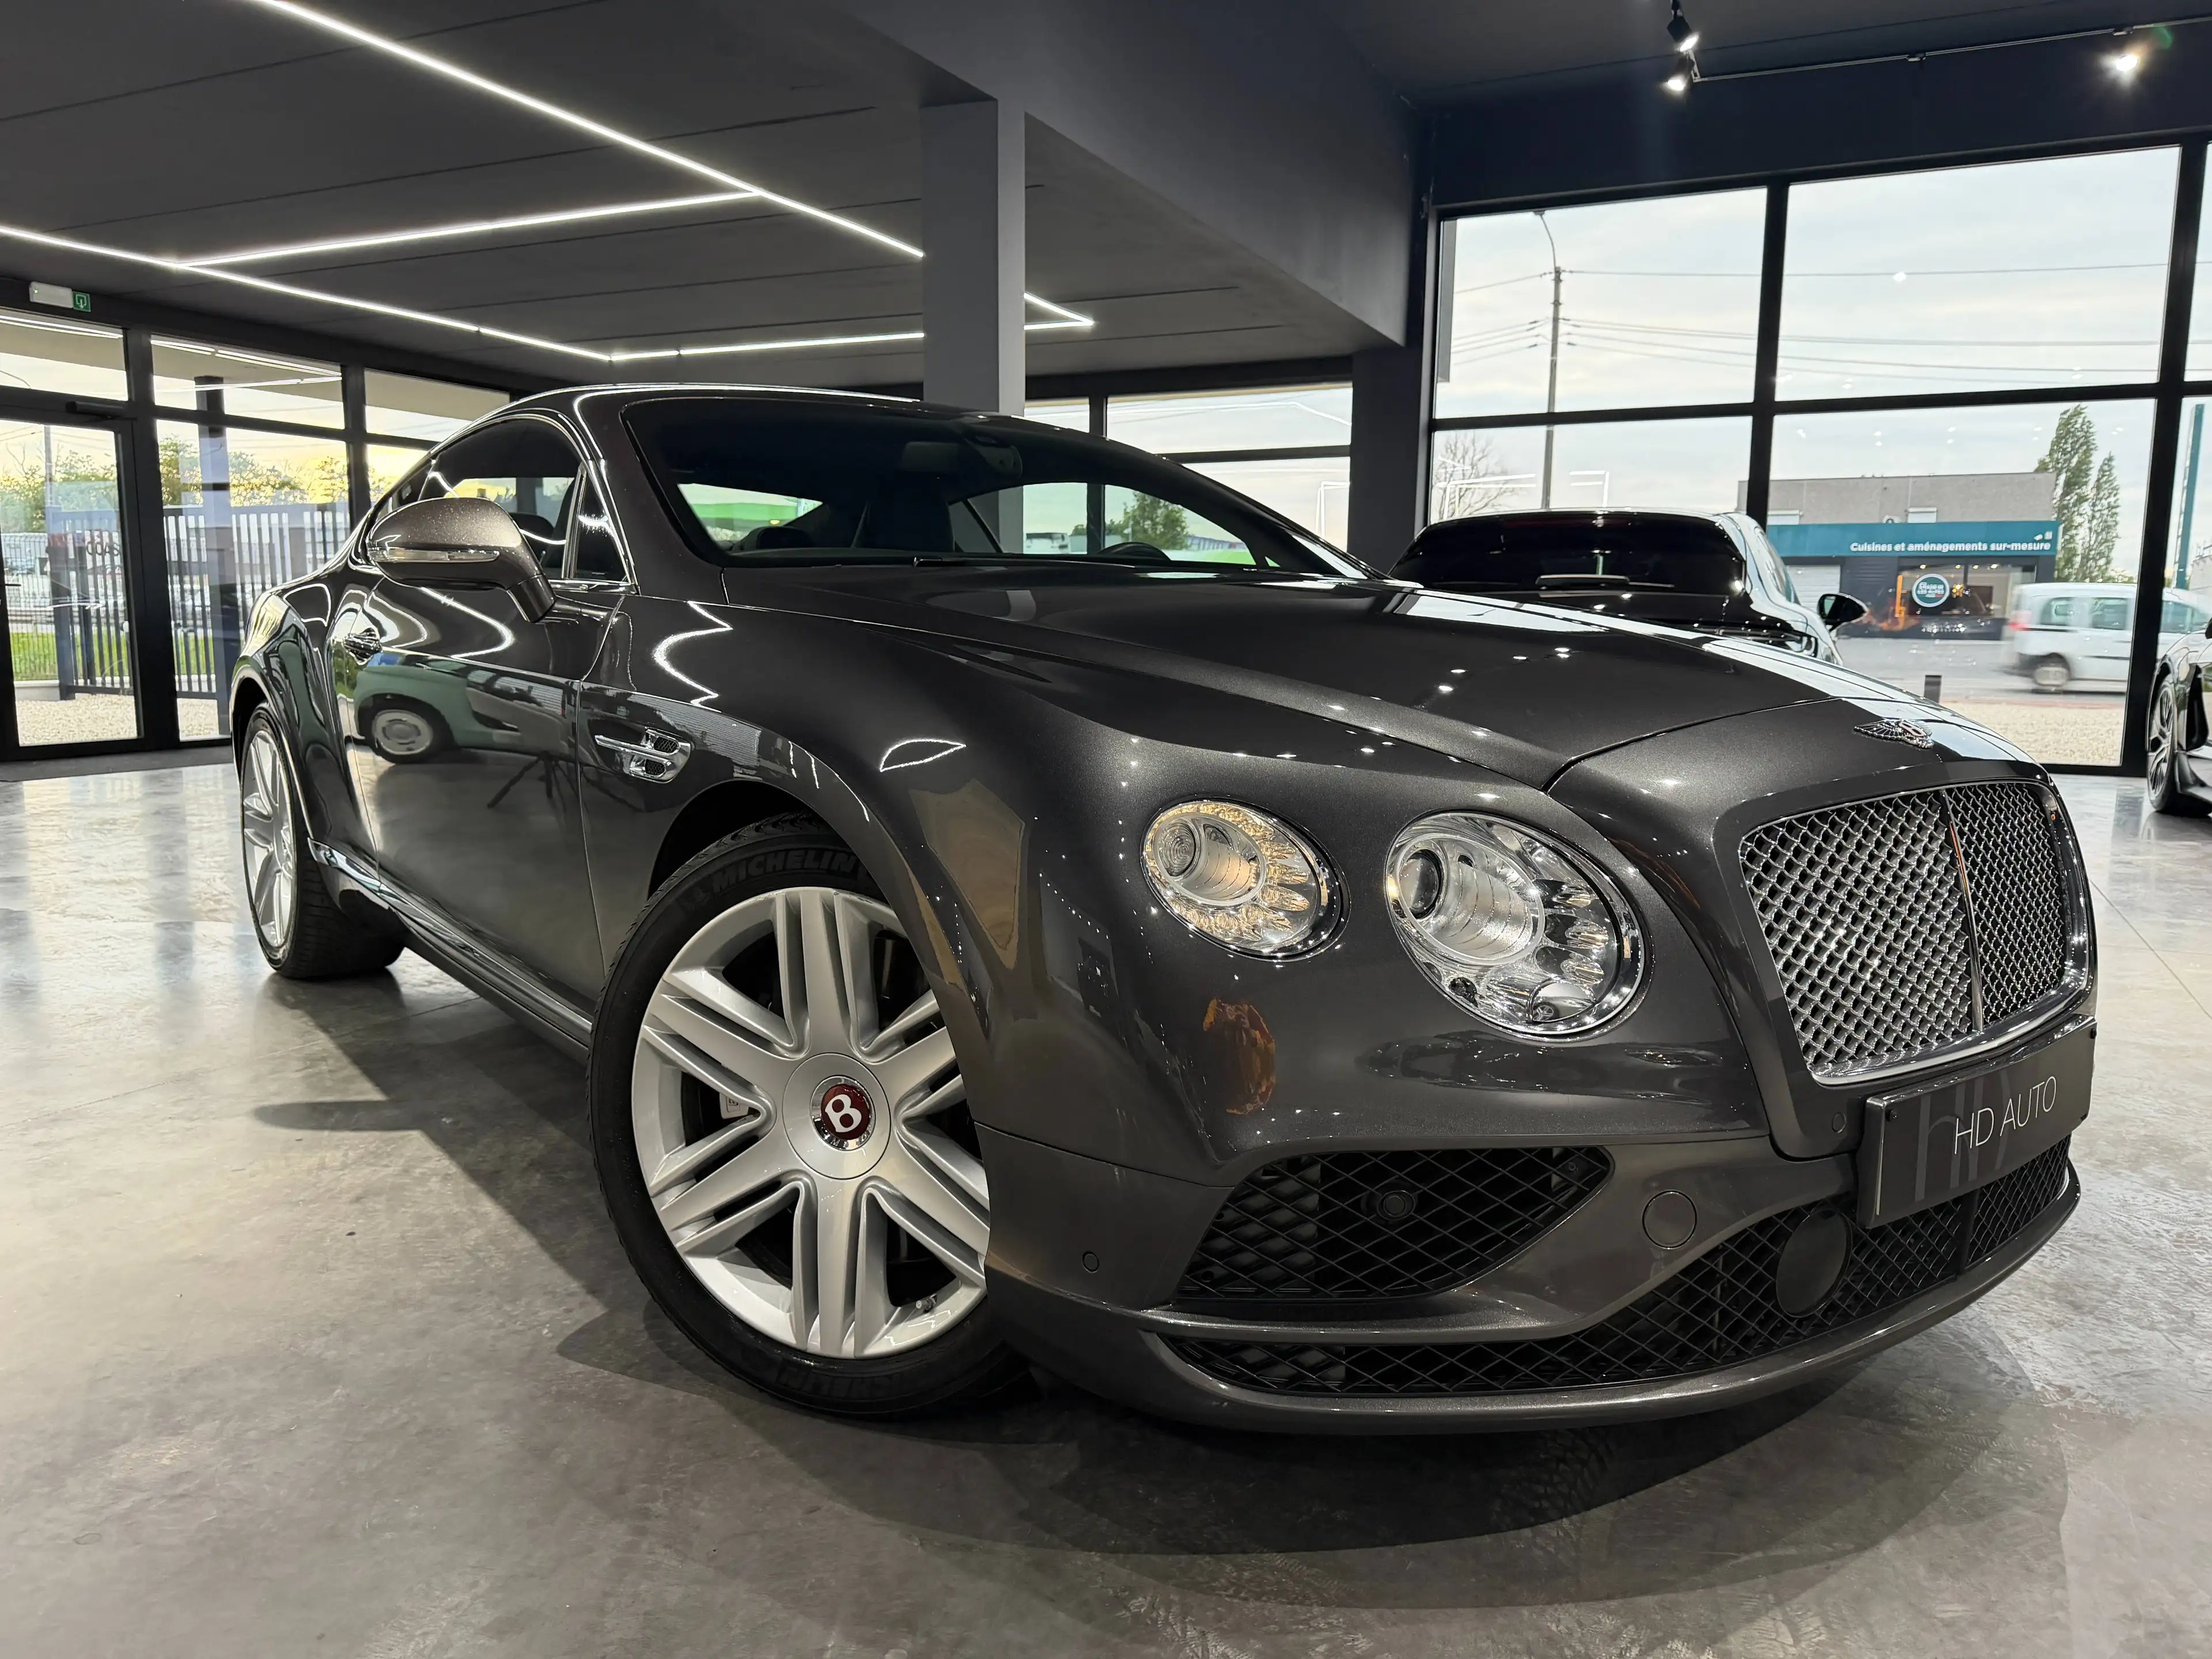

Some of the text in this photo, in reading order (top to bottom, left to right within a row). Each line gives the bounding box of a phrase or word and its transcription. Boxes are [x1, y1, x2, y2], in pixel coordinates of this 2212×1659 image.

[1850, 541, 2051, 552] Cuisines et aménagements sur-mesure
[713, 849, 857, 893] MICHELIN
[825, 1094, 862, 1133] B
[1955, 1076, 2056, 1155] HD AUTO
